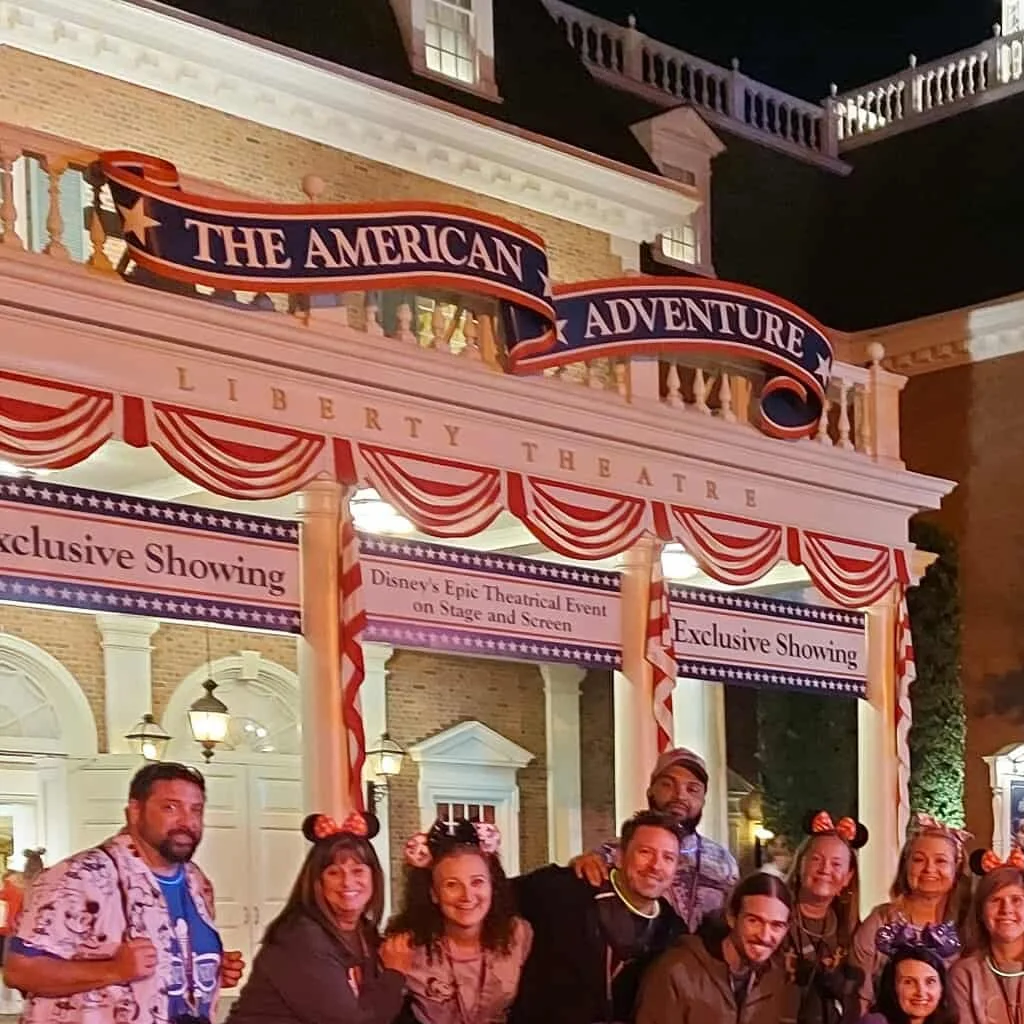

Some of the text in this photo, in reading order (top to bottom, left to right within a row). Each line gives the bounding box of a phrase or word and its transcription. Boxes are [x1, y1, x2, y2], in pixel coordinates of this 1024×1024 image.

[185, 217, 523, 283] THE AMERICAN
[584, 297, 804, 358] ADVENTURE
[176, 366, 757, 508] LIBERTY THEATRE
[145, 542, 286, 596] Showing
[370, 568, 607, 617] Disney's Epic Theatrical Event
[412, 600, 572, 633] on Stage and Screen
[673, 618, 858, 671] Exclusive Showing
